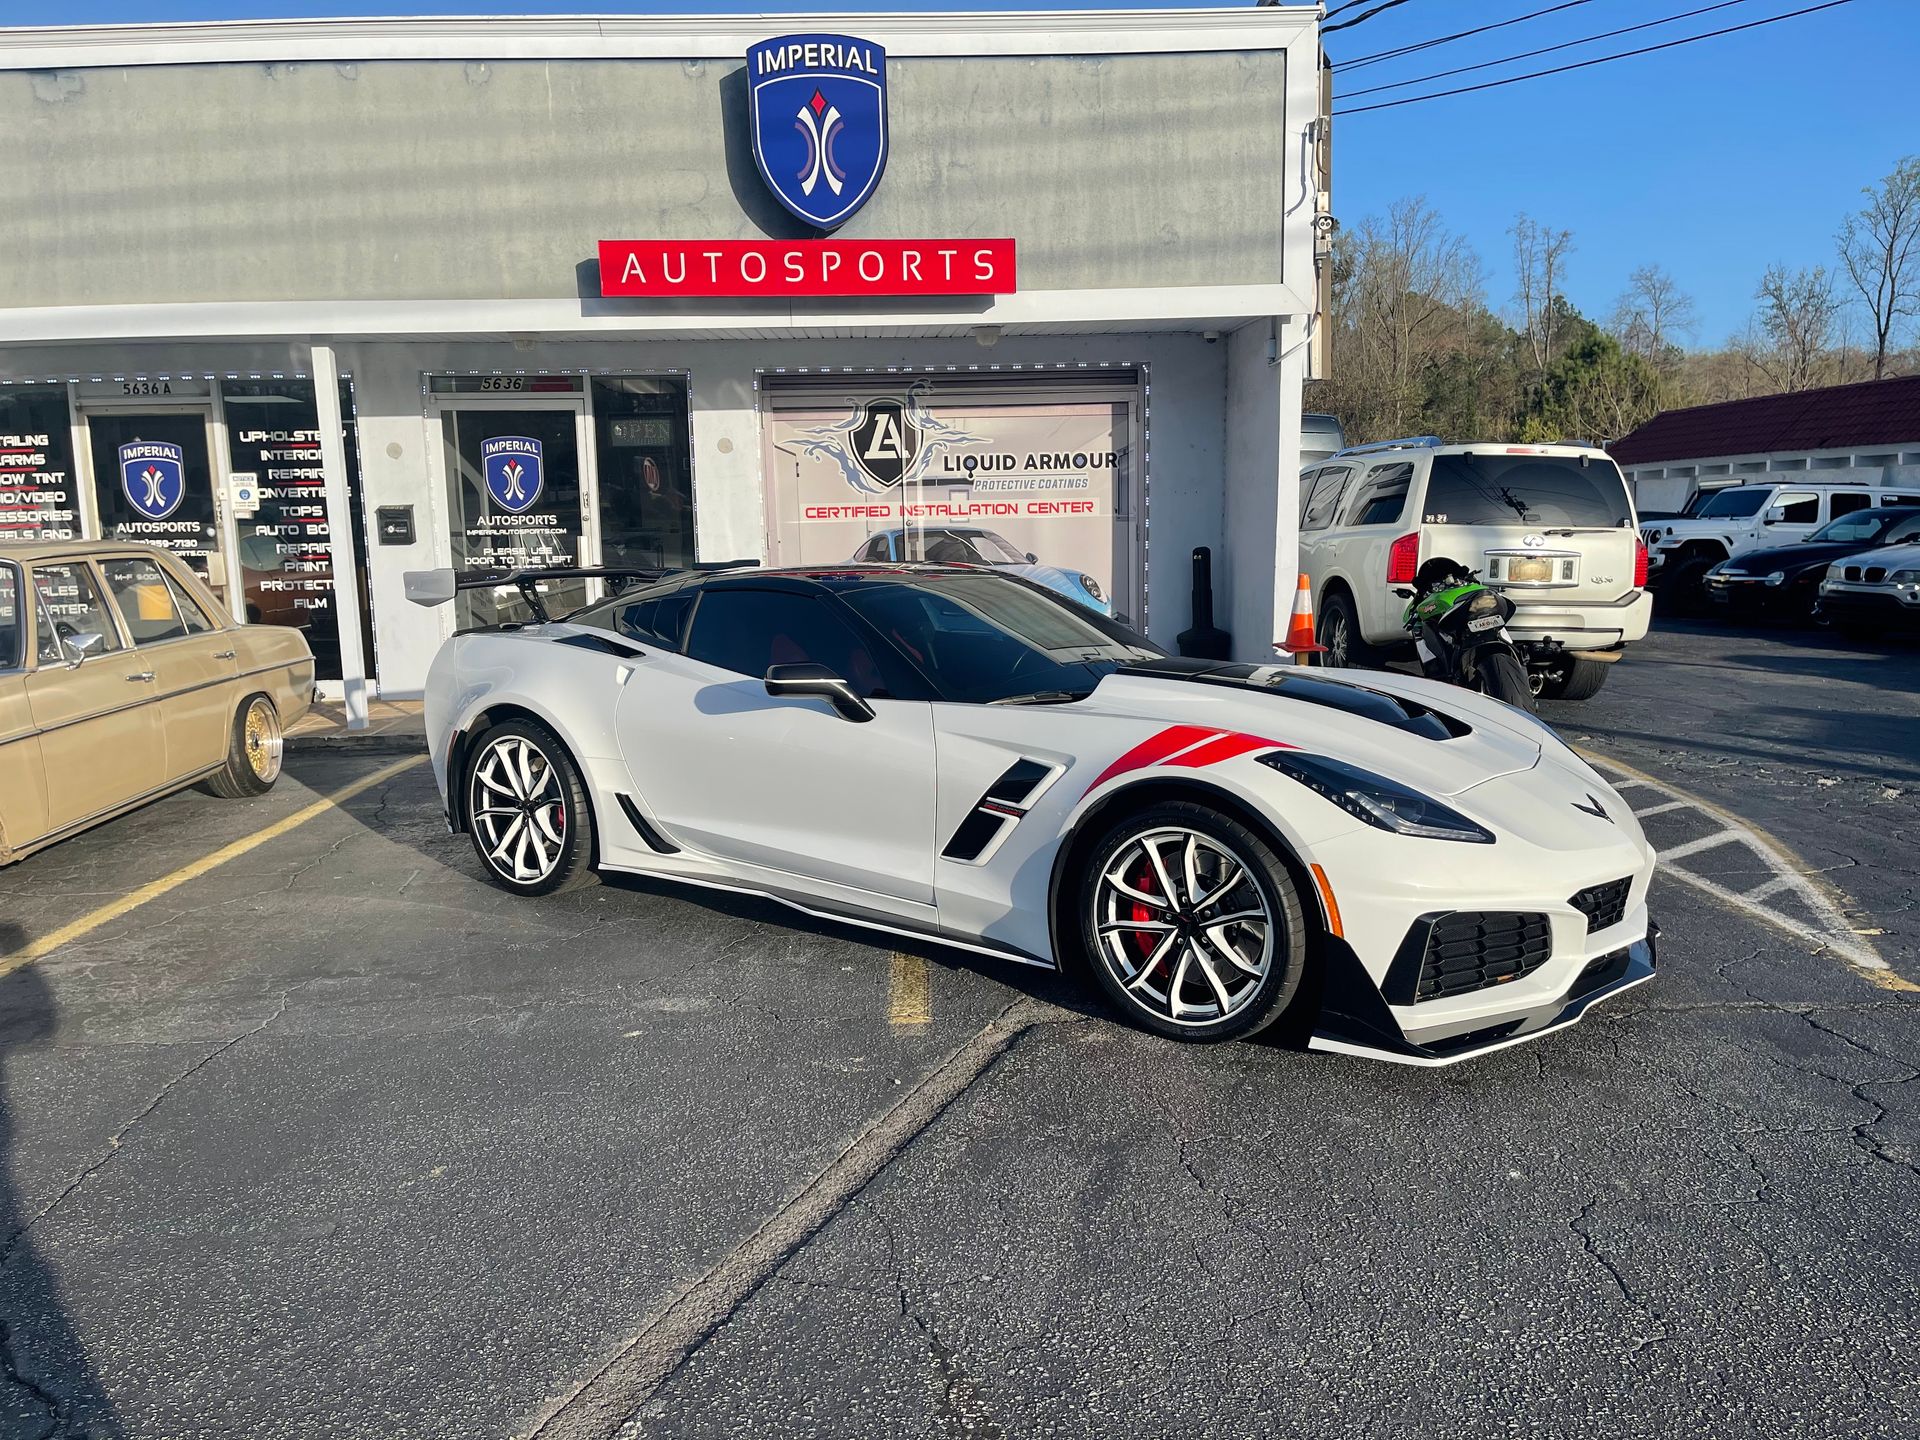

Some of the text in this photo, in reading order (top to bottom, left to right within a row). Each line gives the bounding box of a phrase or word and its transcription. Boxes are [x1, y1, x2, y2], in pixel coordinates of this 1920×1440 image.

[757, 43, 878, 75] IMPERIAL
[621, 250, 994, 283] AUTOSPORTS
[482, 377, 522, 390] 5636
[123, 445, 179, 460] IMPERIAL
[484, 440, 539, 454] IMPERIAL
[943, 452, 1118, 477] LIQUID ARMOUR
[32, 472, 66, 484] TINT
[267, 468, 325, 480] REPAIR
[974, 478, 1089, 491] PROTECTIVE COATINGS
[278, 506, 323, 517] TOPS
[805, 501, 1094, 519] CERTIFIED INSTALLATION CENTER
[476, 515, 558, 526] AUTOSPORTS
[41, 528, 73, 540] AND
[116, 522, 201, 534] AUTOSPORTS
[256, 524, 330, 536] AUTO BO
[275, 543, 332, 555] REPAIR
[483, 547, 553, 556] PLEASE USE
[464, 555, 573, 565] DOOR TO THE LEFT
[284, 561, 329, 573] PAINT
[39, 585, 79, 597] ALES
[294, 598, 328, 609] FILM
